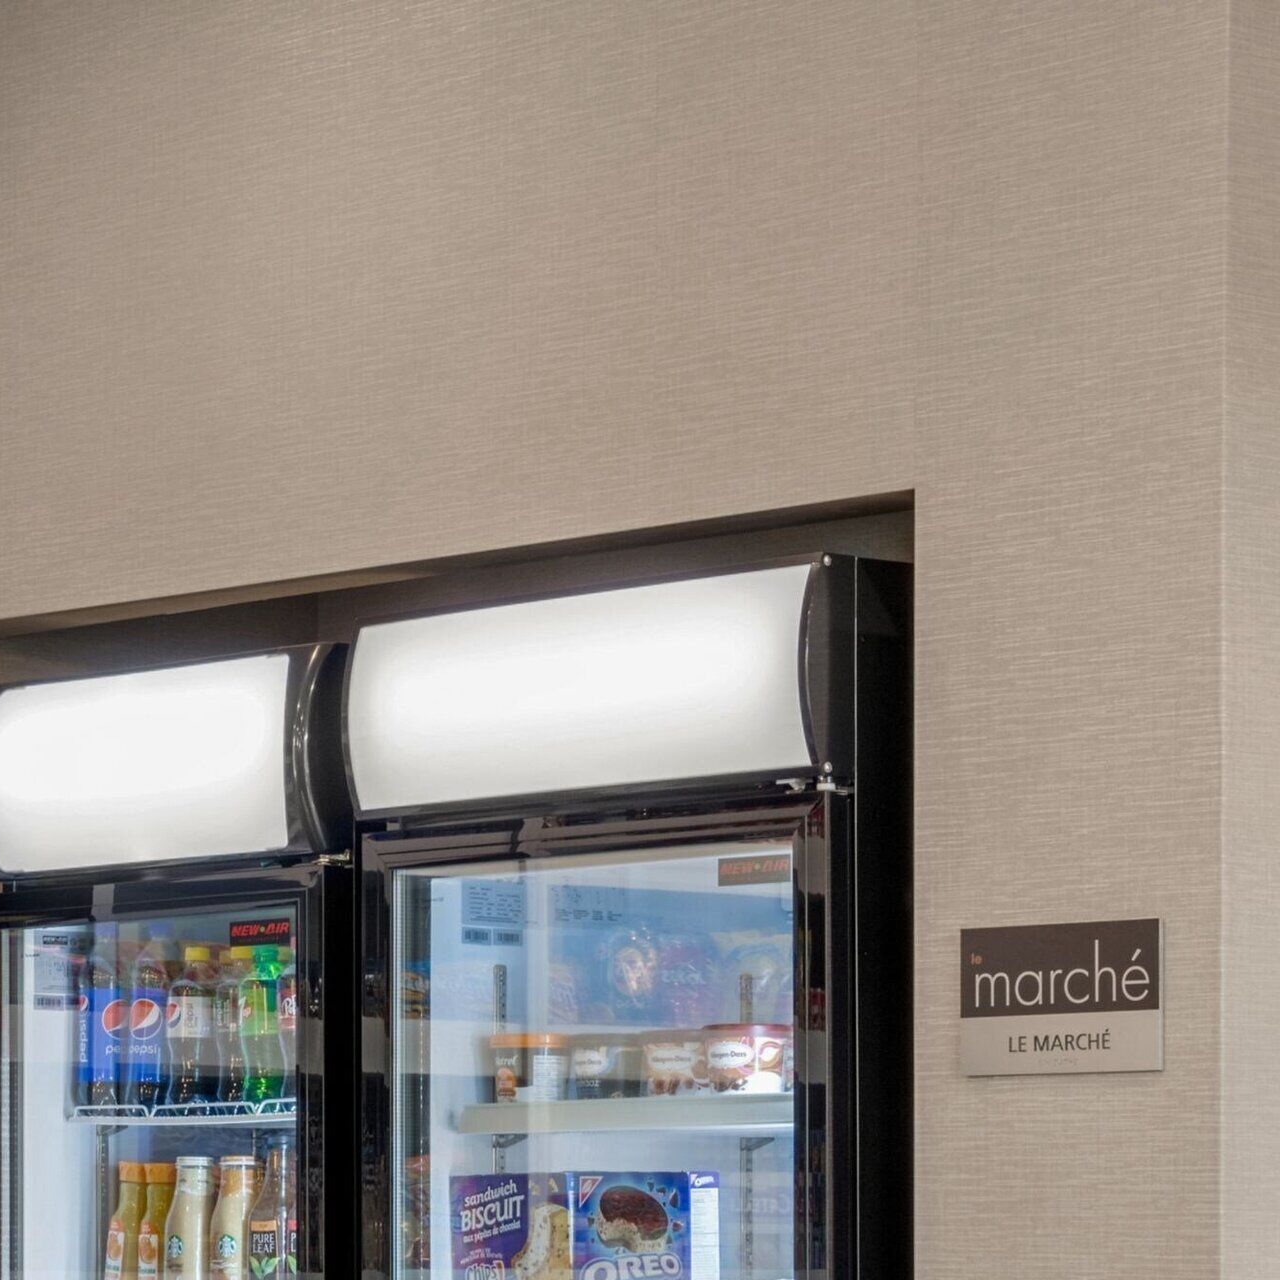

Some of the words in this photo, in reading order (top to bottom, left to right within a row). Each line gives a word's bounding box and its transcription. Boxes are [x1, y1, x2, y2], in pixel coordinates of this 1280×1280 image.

[975, 939, 1150, 1008] marché
[79, 1020, 88, 1063] pepsi
[1008, 1036, 1027, 1053] LE
[1034, 1028, 1111, 1052] MARCHÉ
[464, 1179, 518, 1207] sandwich
[460, 1195, 525, 1233] BISCUIT
[252, 1233, 275, 1244] PURE
[252, 1243, 275, 1253] LEAF
